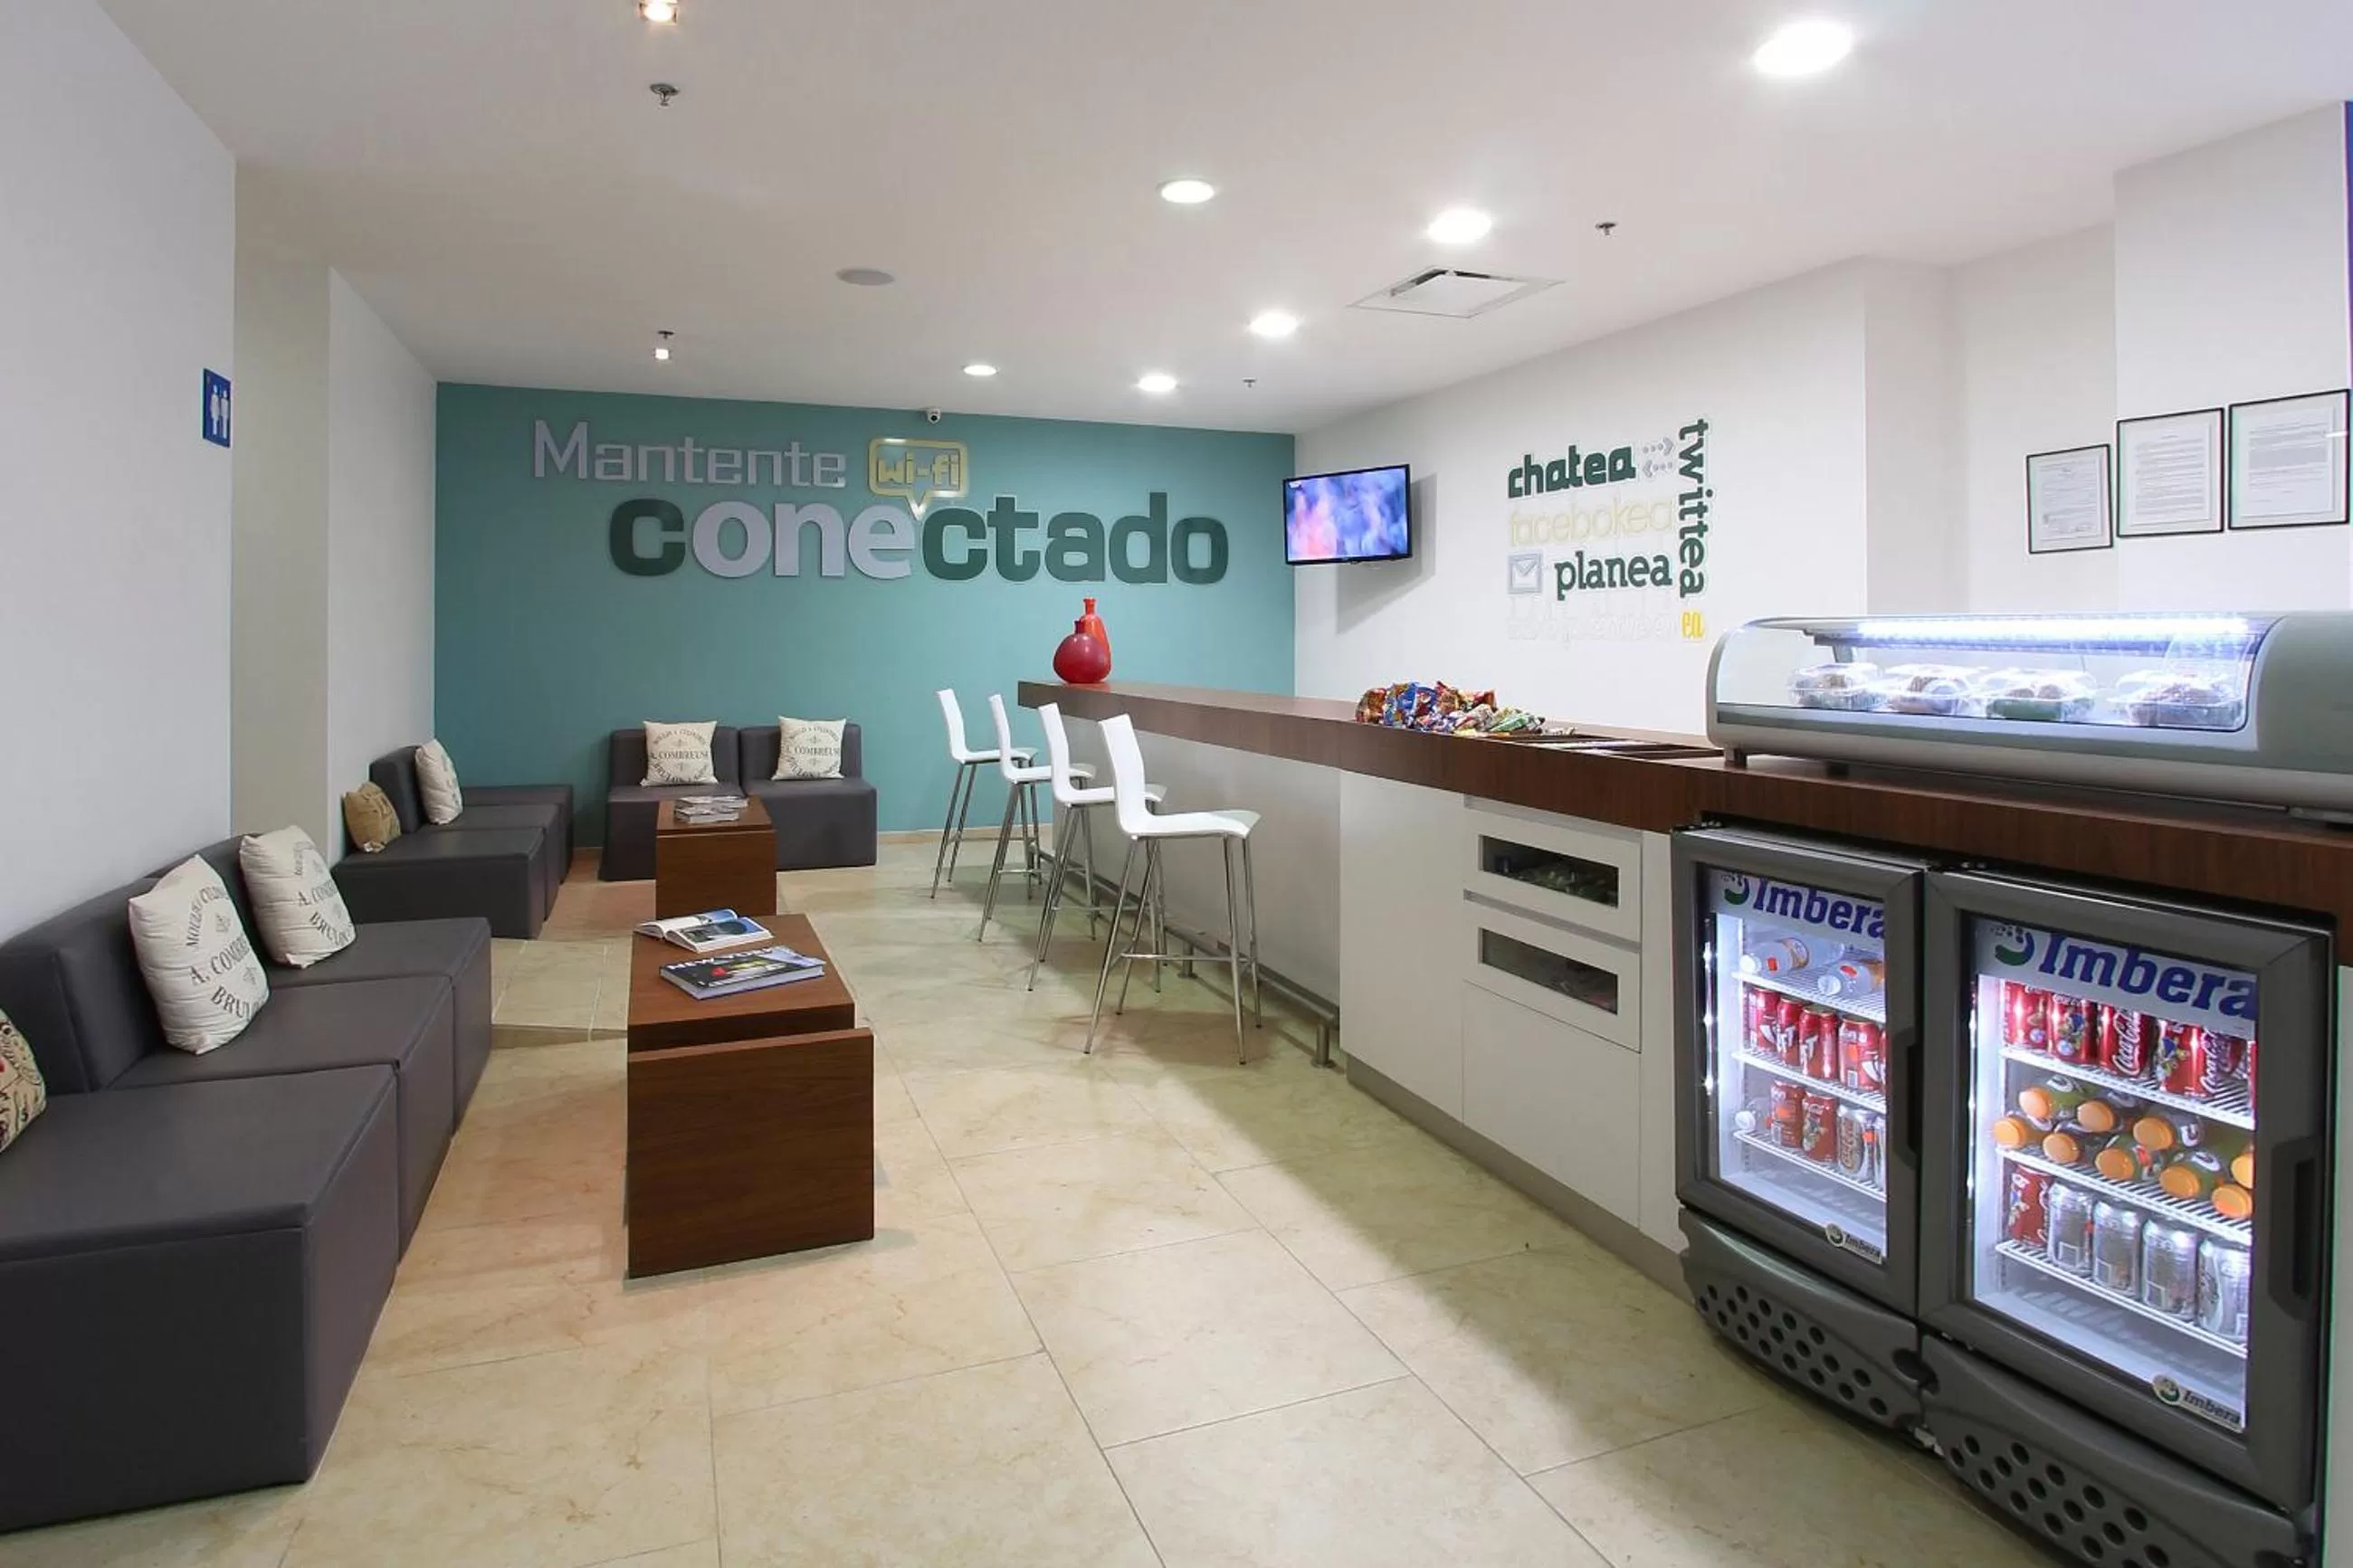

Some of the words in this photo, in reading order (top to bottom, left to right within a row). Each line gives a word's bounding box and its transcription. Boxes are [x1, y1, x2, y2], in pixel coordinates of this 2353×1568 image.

[534, 420, 847, 489] Mantente
[878, 451, 959, 486] wi-fi
[1508, 445, 1636, 499] chatea
[609, 492, 1230, 585] conectado
[1679, 419, 1713, 598] twittea
[1554, 551, 1672, 601] planea
[1753, 875, 1886, 939] Imbera
[2038, 932, 2259, 1021] Imbera
